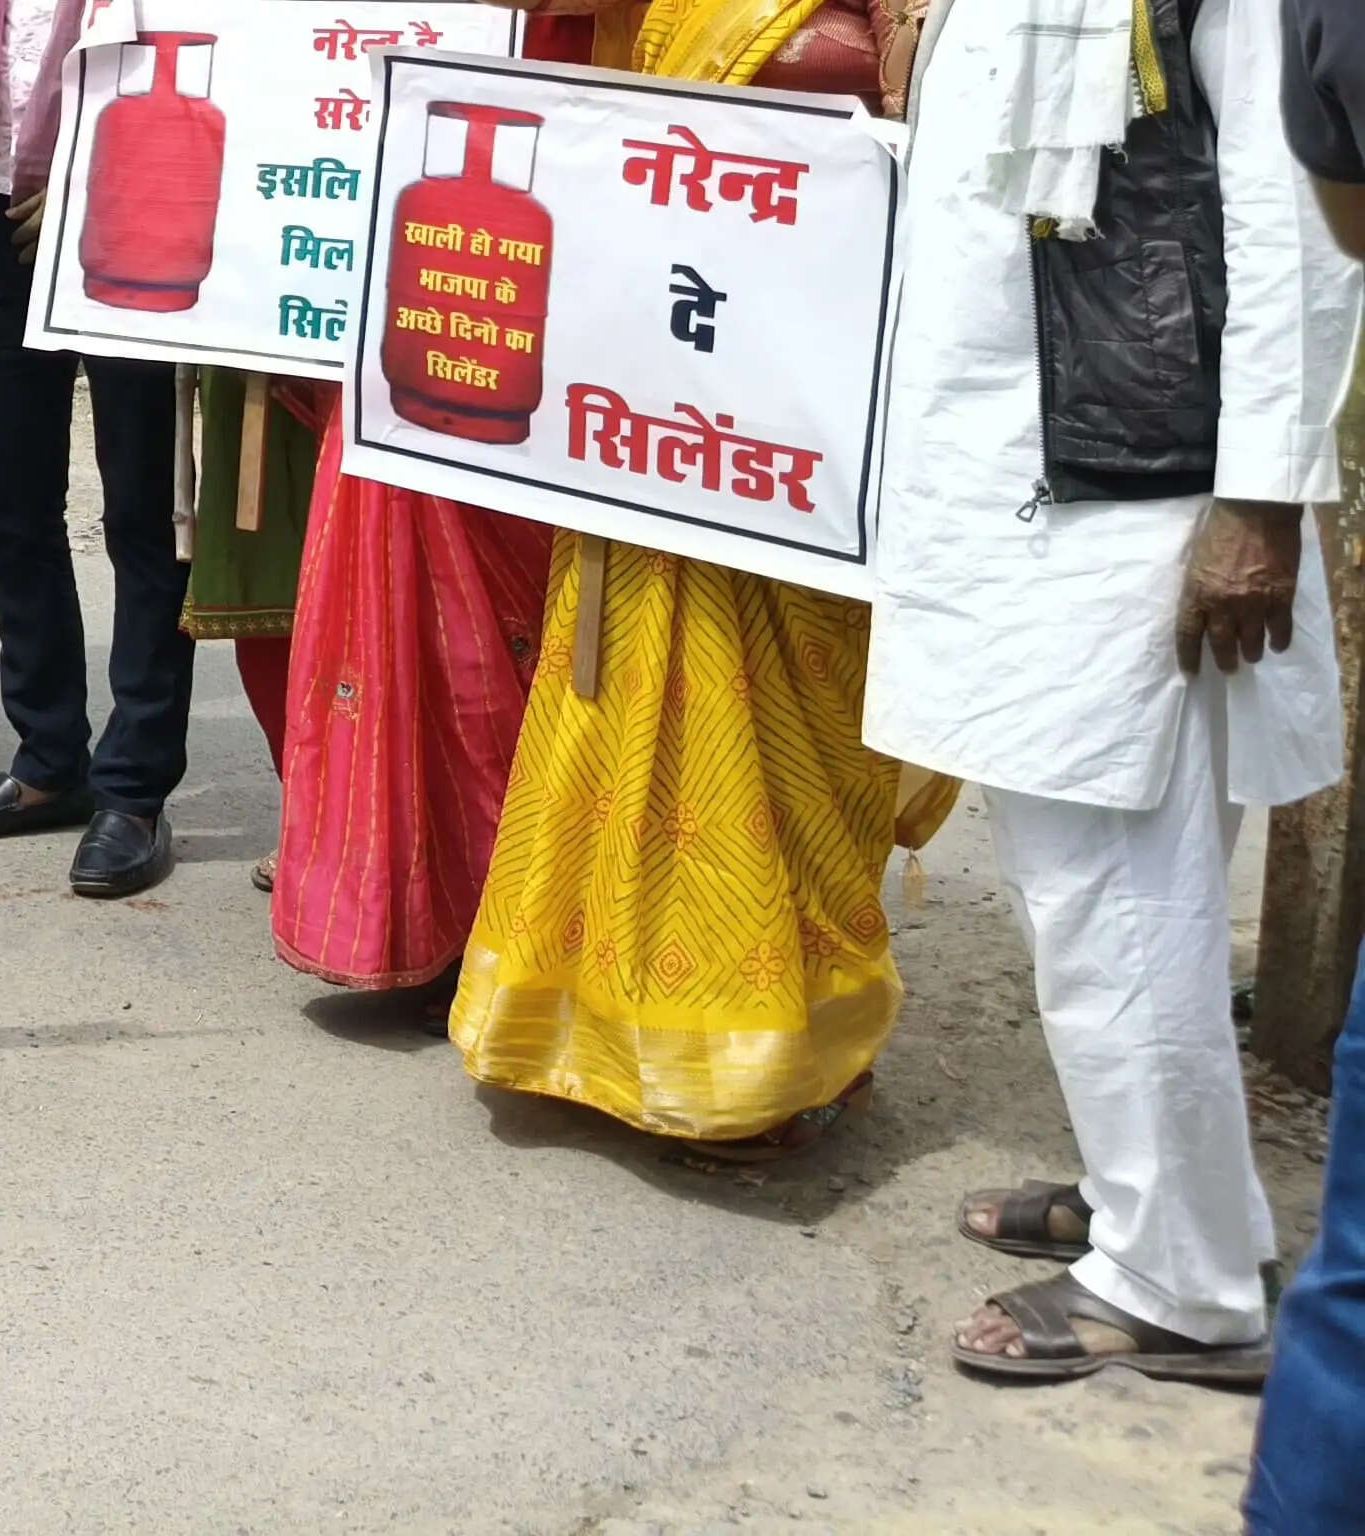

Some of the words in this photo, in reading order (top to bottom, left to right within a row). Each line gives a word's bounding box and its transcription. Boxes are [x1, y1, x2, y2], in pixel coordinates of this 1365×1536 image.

[314, 89, 370, 131] सरे
[622, 124, 809, 226] नरेन्द्र
[405, 222, 465, 252] खाली
[470, 228, 493, 256] हो
[499, 237, 544, 265] गया
[420, 269, 488, 300] भाजपा
[494, 277, 518, 303] के
[669, 264, 727, 353] दे
[396, 306, 444, 334] अच्छे
[449, 311, 500, 346] दिनो
[505, 328, 535, 354] का
[426, 350, 500, 391] सिलेंडर
[565, 383, 823, 513] सिलेंडर
